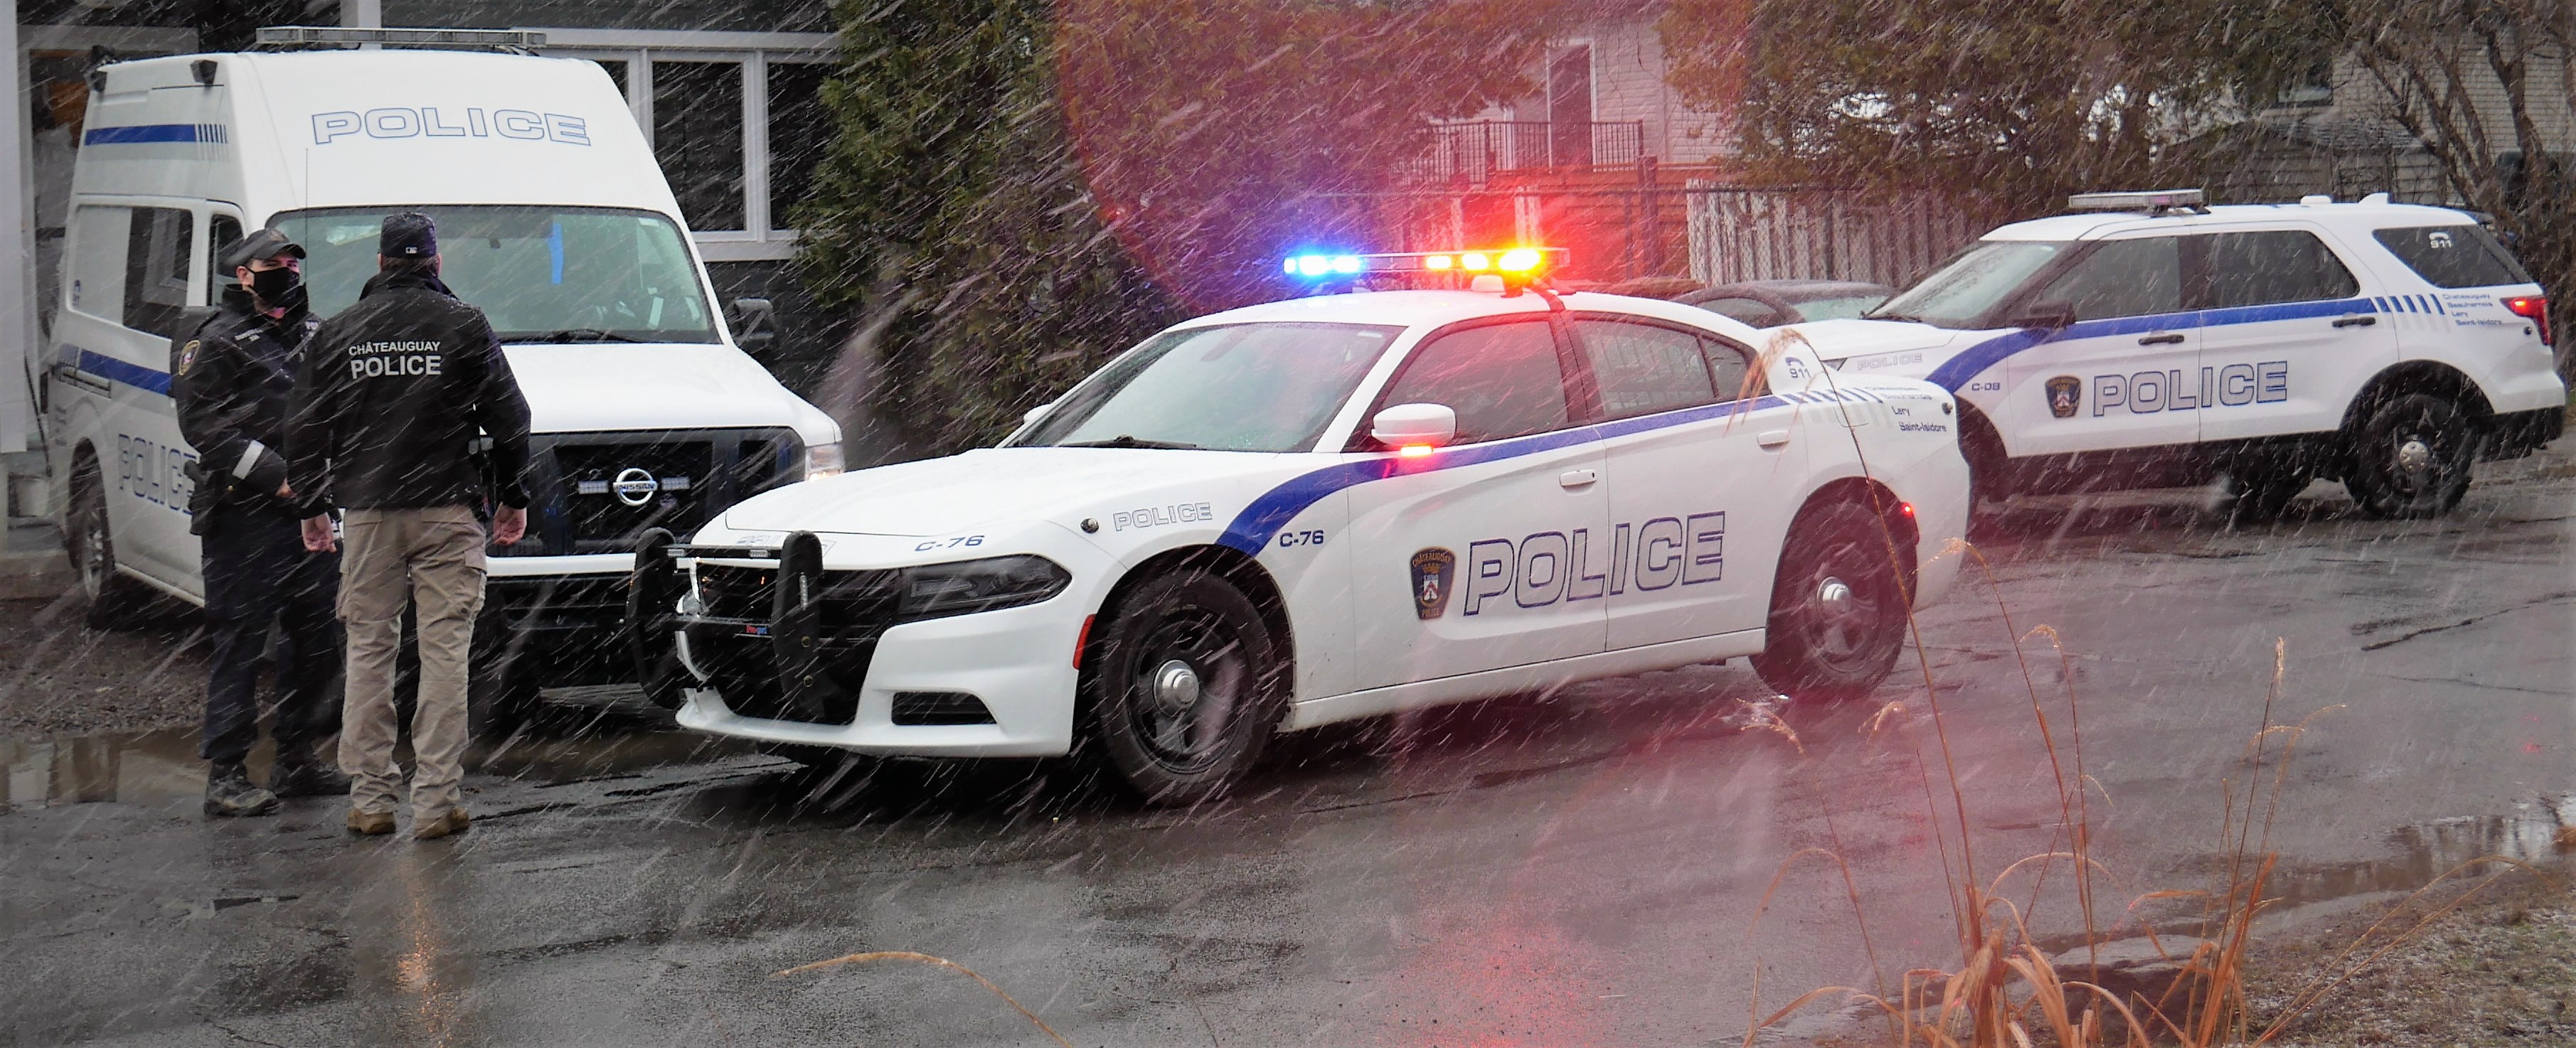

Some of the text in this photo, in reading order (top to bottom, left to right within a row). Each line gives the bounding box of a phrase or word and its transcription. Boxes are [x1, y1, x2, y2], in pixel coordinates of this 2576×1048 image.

[312, 107, 591, 146] POLICE
[2430, 240, 2452, 249] 911
[348, 341, 441, 356] CHÂTEAUGUAY
[350, 355, 442, 379] POLICE
[1857, 353, 1922, 371] POLICE
[1789, 368, 1811, 378] 911
[2093, 360, 2288, 417] POLICE
[1899, 422, 1947, 432] Saint-Isidore
[618, 482, 656, 491] NISSAN
[1113, 502, 1213, 531] POLICE
[915, 535, 985, 552] C-76
[1279, 530, 1324, 547] C-76
[1463, 510, 1725, 616] POLICE
